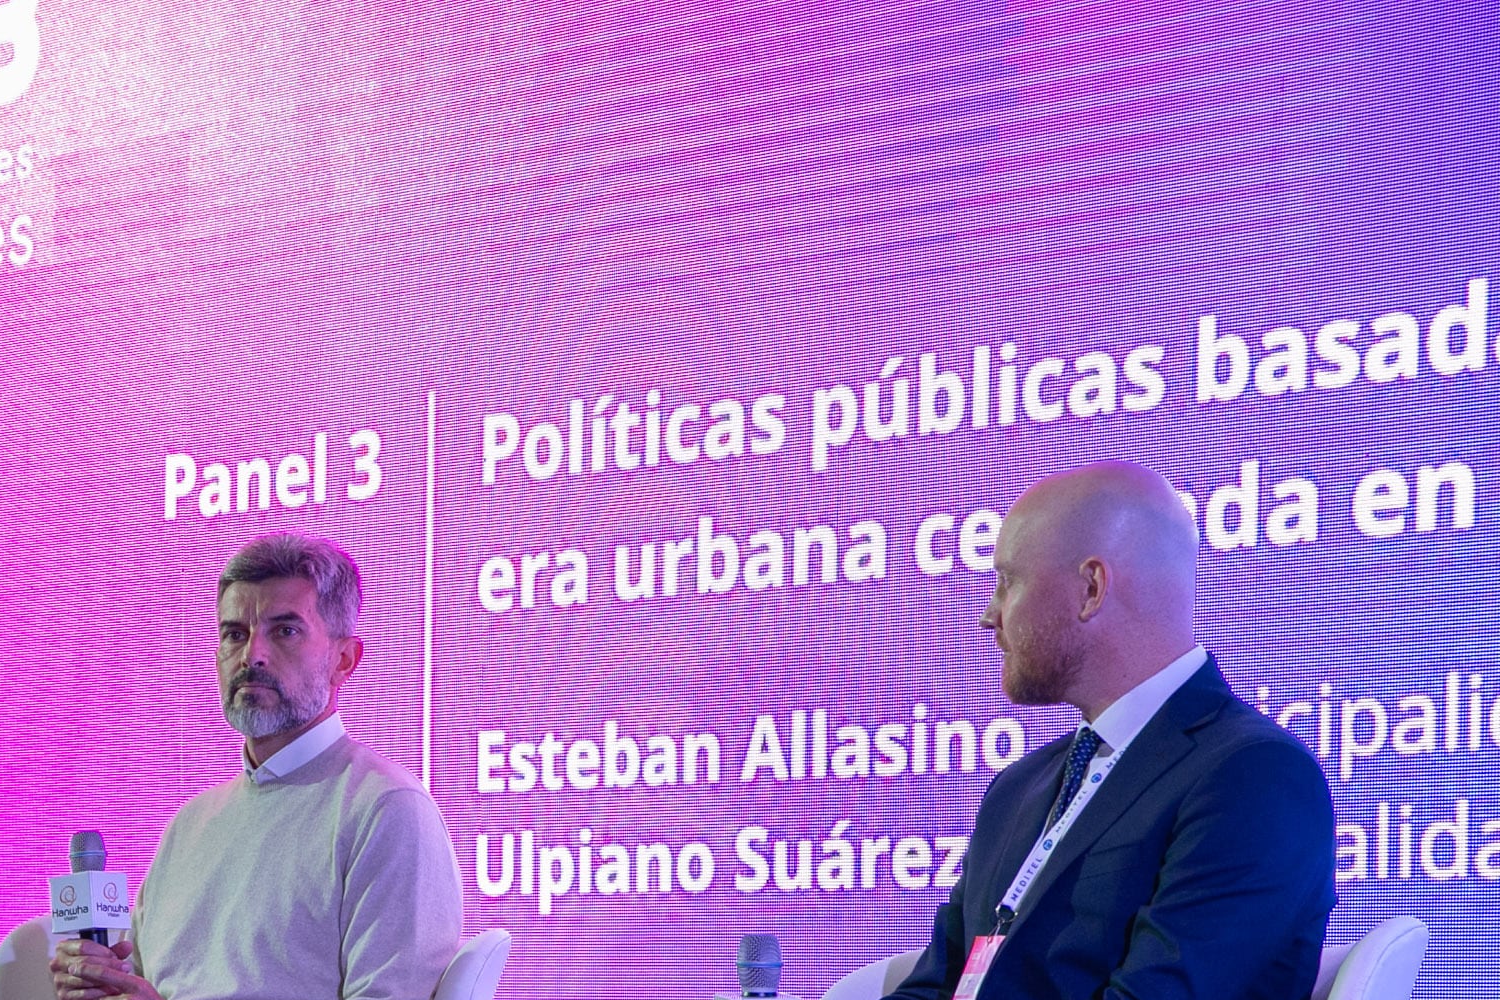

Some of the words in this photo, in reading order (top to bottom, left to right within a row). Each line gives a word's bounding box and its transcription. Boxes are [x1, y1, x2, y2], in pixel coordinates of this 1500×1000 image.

[481, 389, 786, 485] Políticas
[811, 341, 1166, 472] públicas
[1196, 278, 1500, 403] basad
[163, 431, 328, 520] Panel
[346, 429, 384, 501] 3
[476, 545, 589, 613] era
[614, 516, 888, 602] urbana
[1352, 457, 1476, 537] en
[477, 720, 722, 793] Esteban
[741, 703, 1027, 782] Allasino
[52, 906, 89, 918] Hanwha
[97, 903, 129, 914] Hanwha
[475, 829, 716, 915] Ulpiano
[735, 820, 973, 893] Suárez
[1010, 857, 1043, 902] MEDITEL
